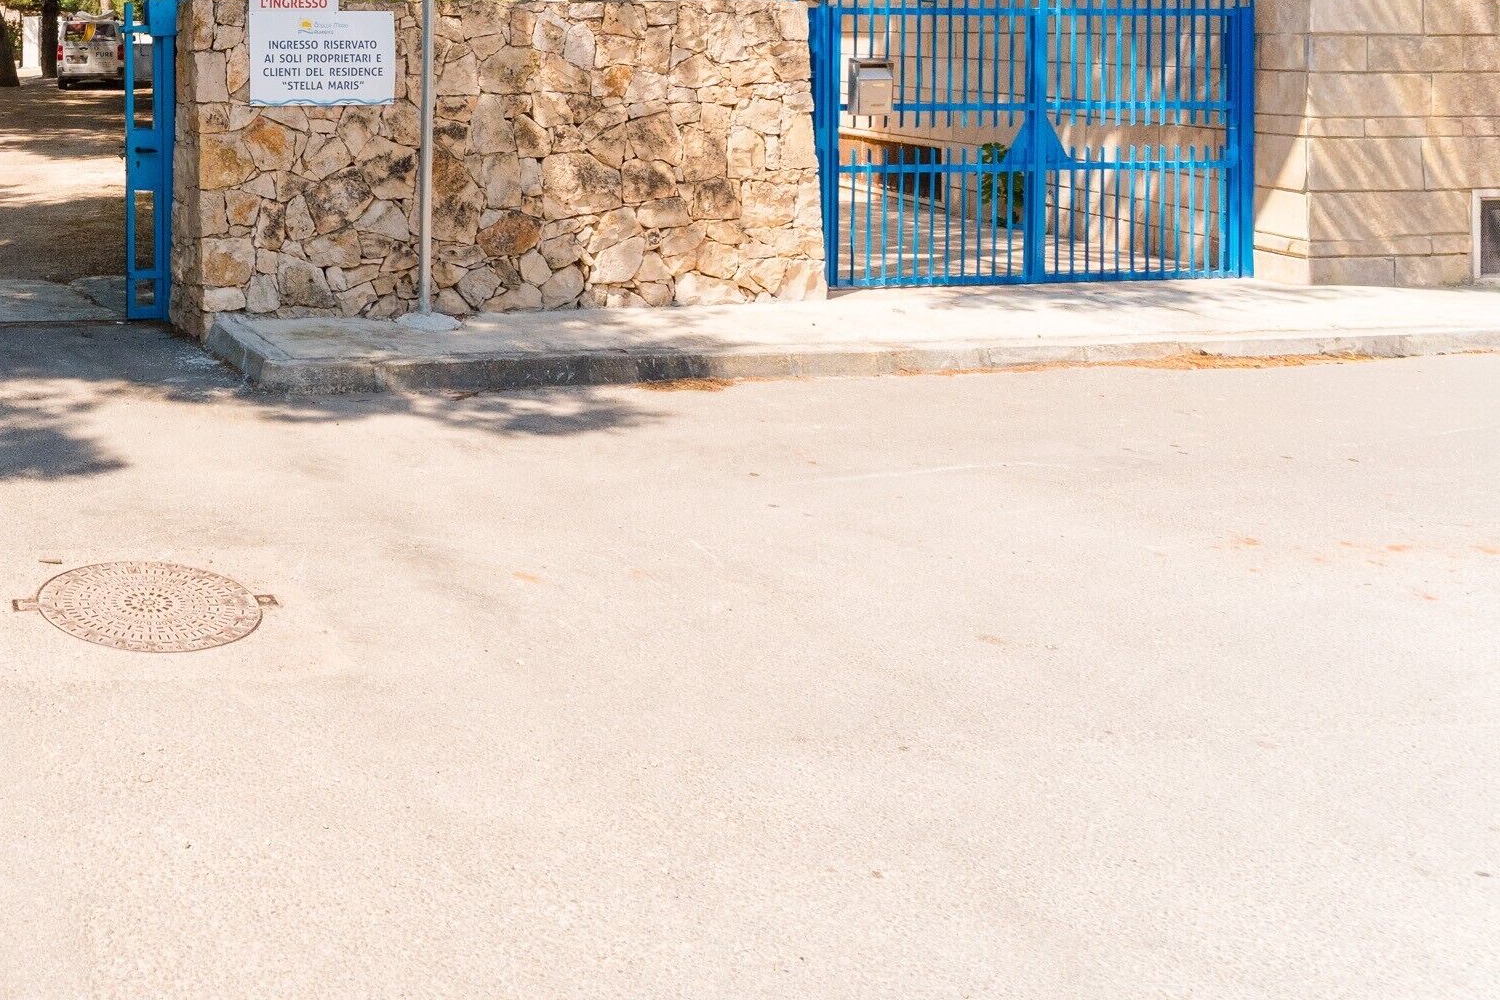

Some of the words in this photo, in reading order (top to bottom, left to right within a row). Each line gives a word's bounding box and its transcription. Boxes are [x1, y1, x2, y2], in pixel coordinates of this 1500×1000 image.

[268, 40, 318, 49] INGRESSO
[324, 40, 377, 49] RISERVATO
[264, 54, 274, 63] AI
[279, 54, 302, 63] SOLI
[307, 54, 371, 63] PROPRIETARI
[376, 54, 382, 63] E
[263, 67, 300, 77] CLIENTI
[306, 67, 324, 77] DEL
[329, 67, 383, 77] RESIDENCE
